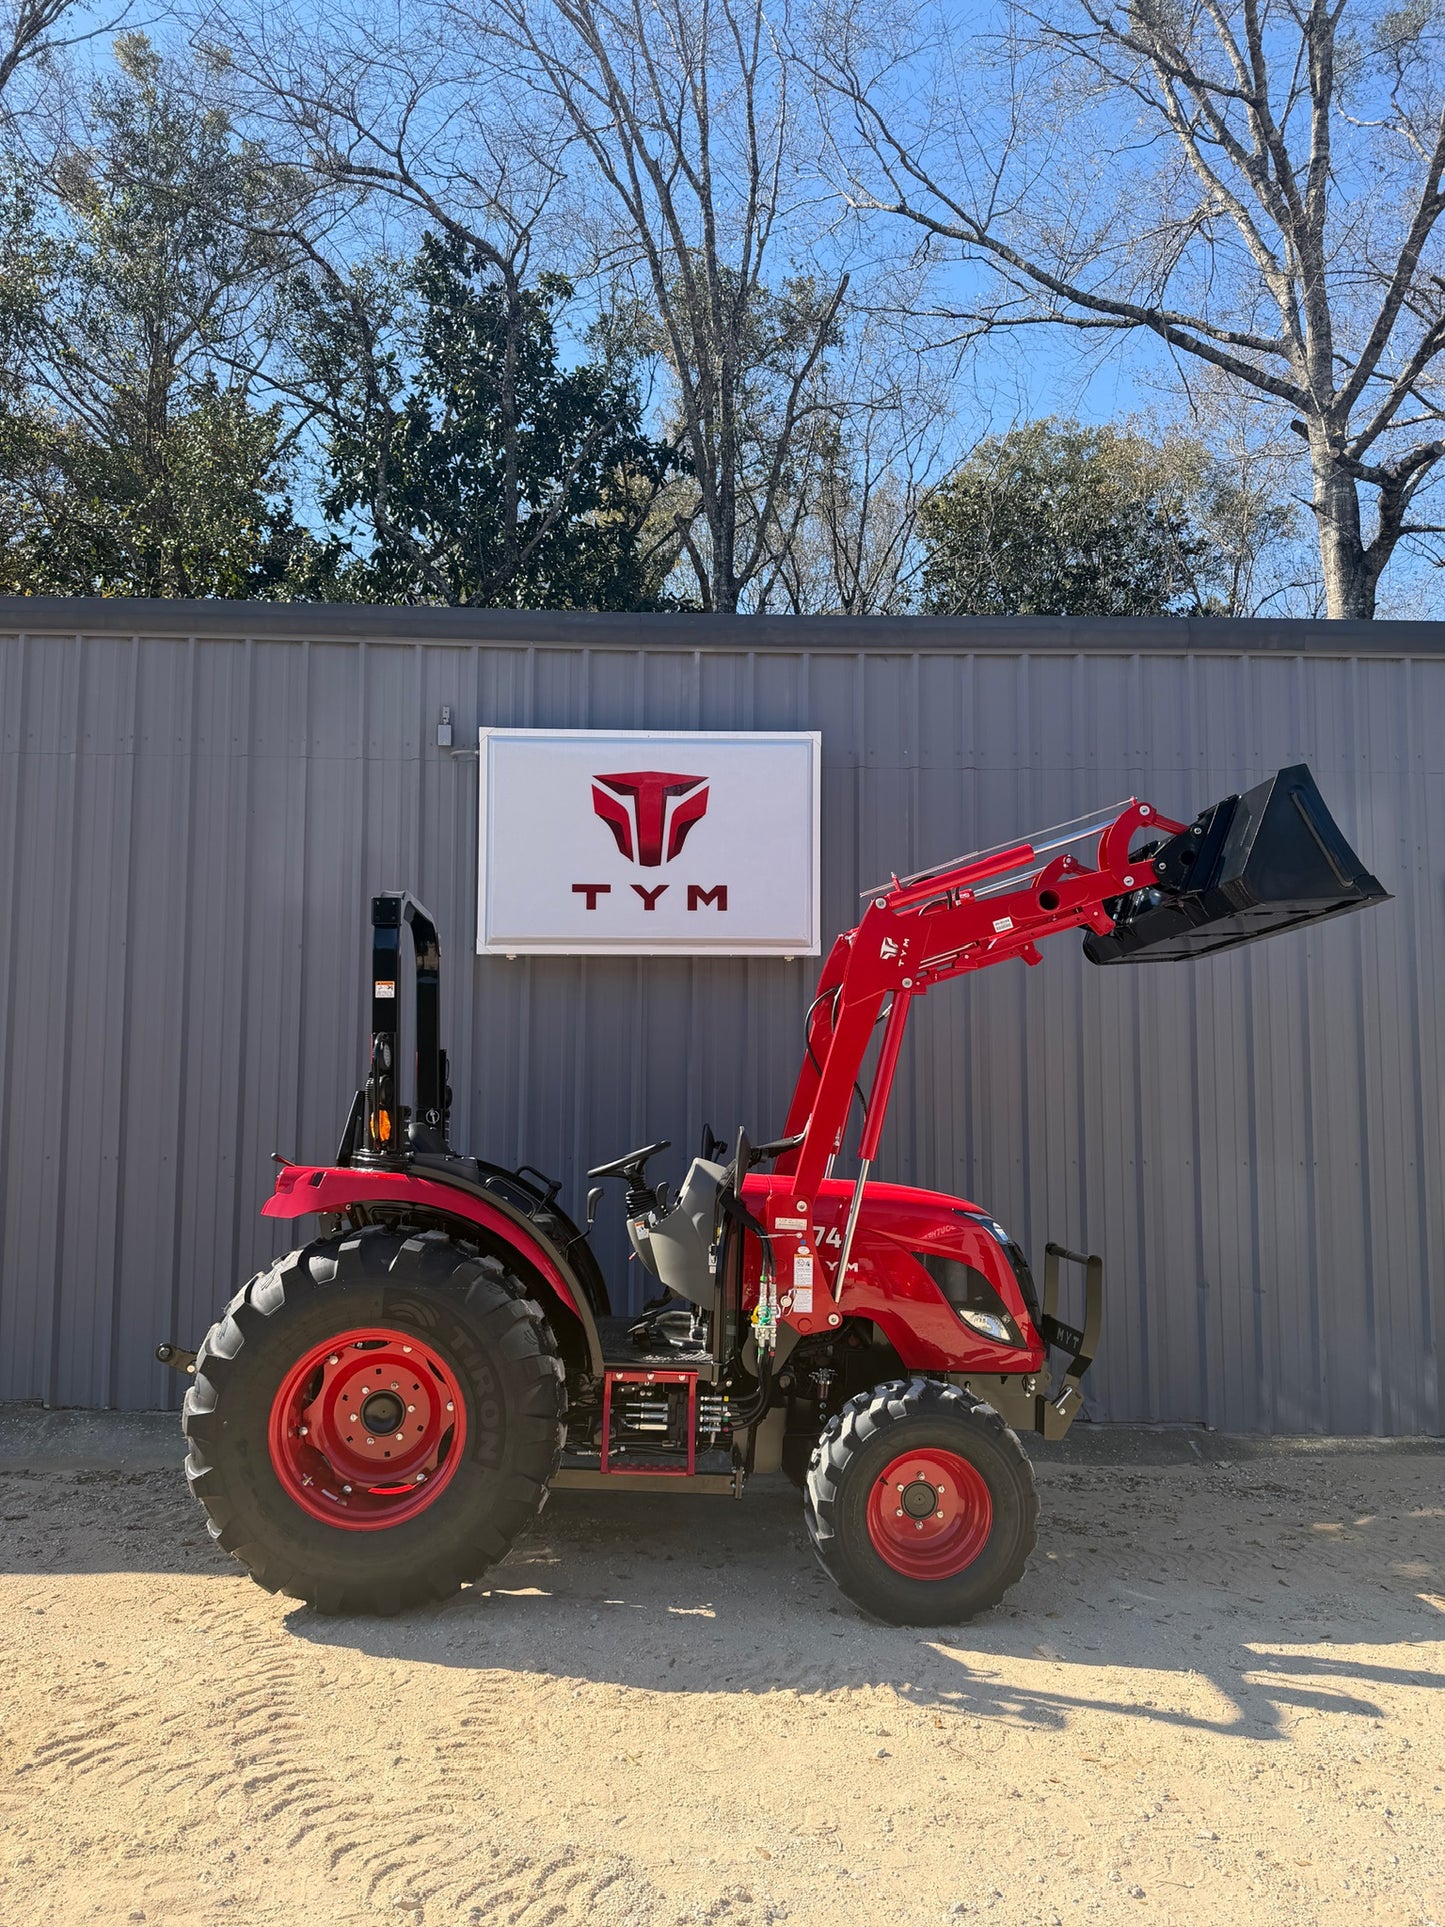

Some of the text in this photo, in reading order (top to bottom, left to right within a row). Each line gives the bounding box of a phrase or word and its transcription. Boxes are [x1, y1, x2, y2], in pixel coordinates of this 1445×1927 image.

[572, 884, 728, 911] TYM
[898, 938, 910, 967] TYM
[813, 1225, 842, 1249] 74
[826, 1261, 859, 1273] YM
[451, 1325, 500, 1461] TIRON
